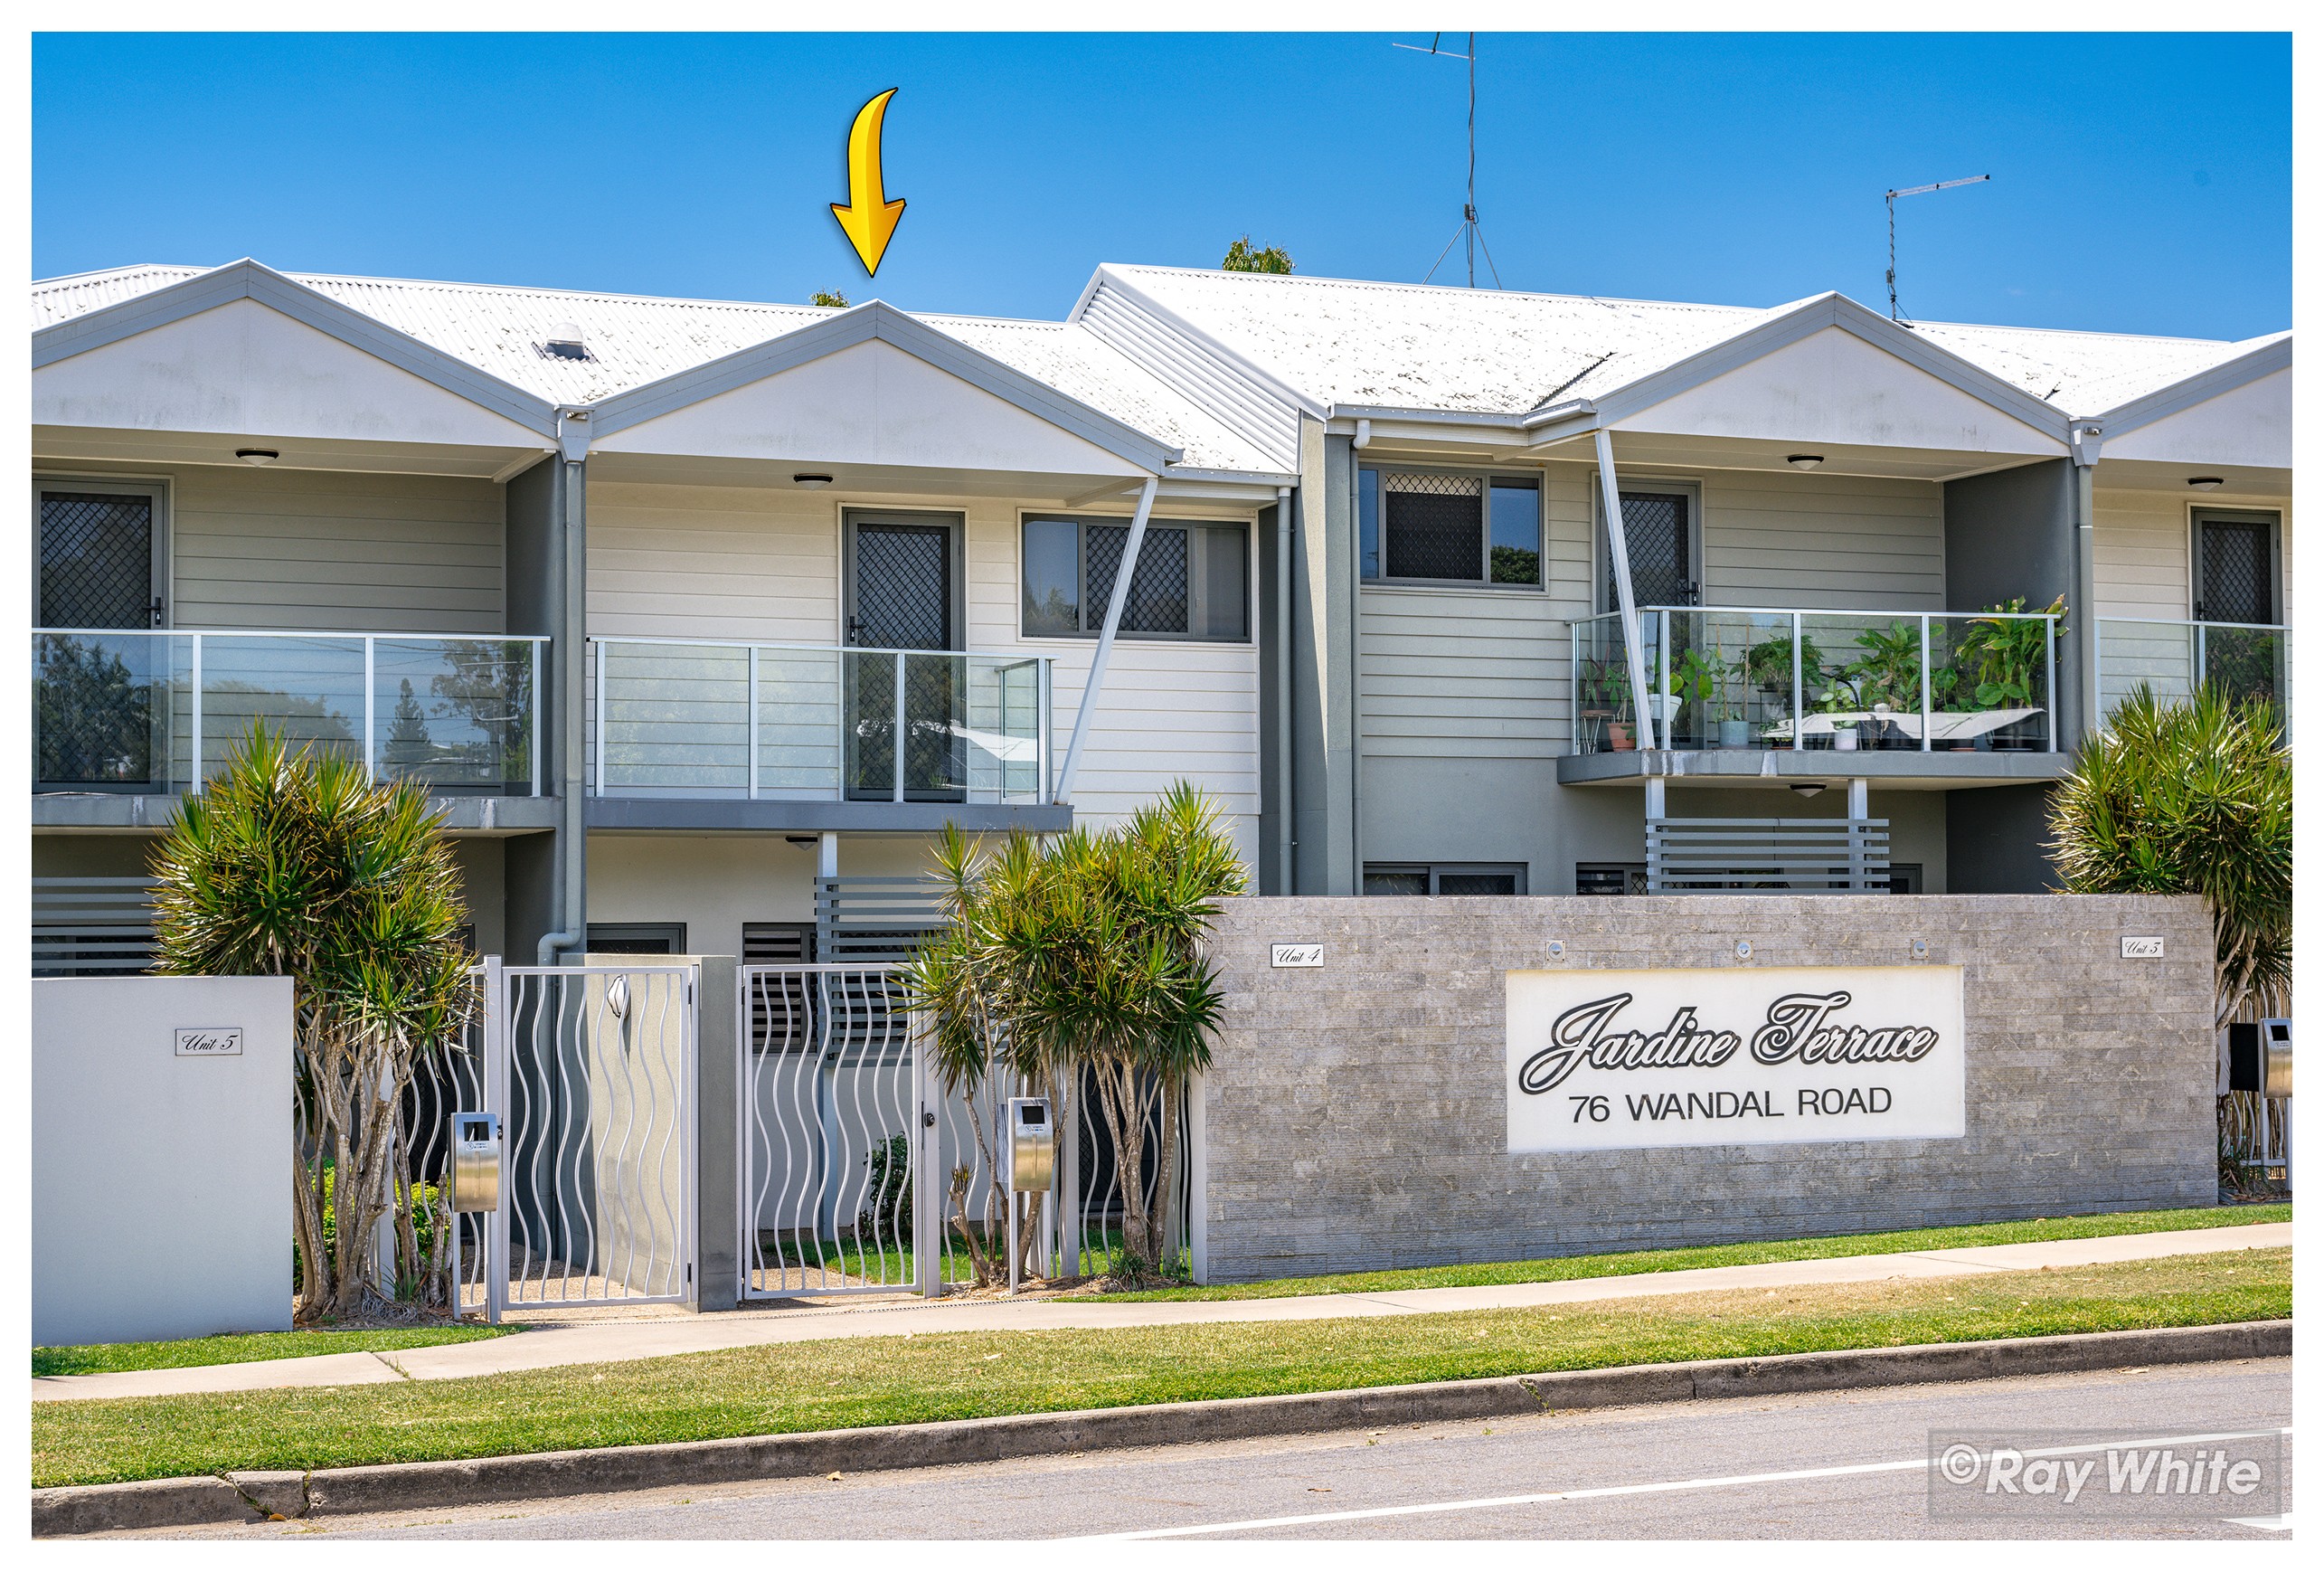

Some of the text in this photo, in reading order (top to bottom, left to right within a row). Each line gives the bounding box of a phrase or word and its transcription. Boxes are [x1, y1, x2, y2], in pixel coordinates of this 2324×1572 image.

[1276, 948, 1321, 963] Unit 4
[2125, 941, 2148, 954] Unit
[182, 1034, 239, 1050] Unit 5
[1519, 990, 1940, 1095] Jardine Terrace
[1568, 1086, 1893, 1123] 76 WANDAL ROAD
